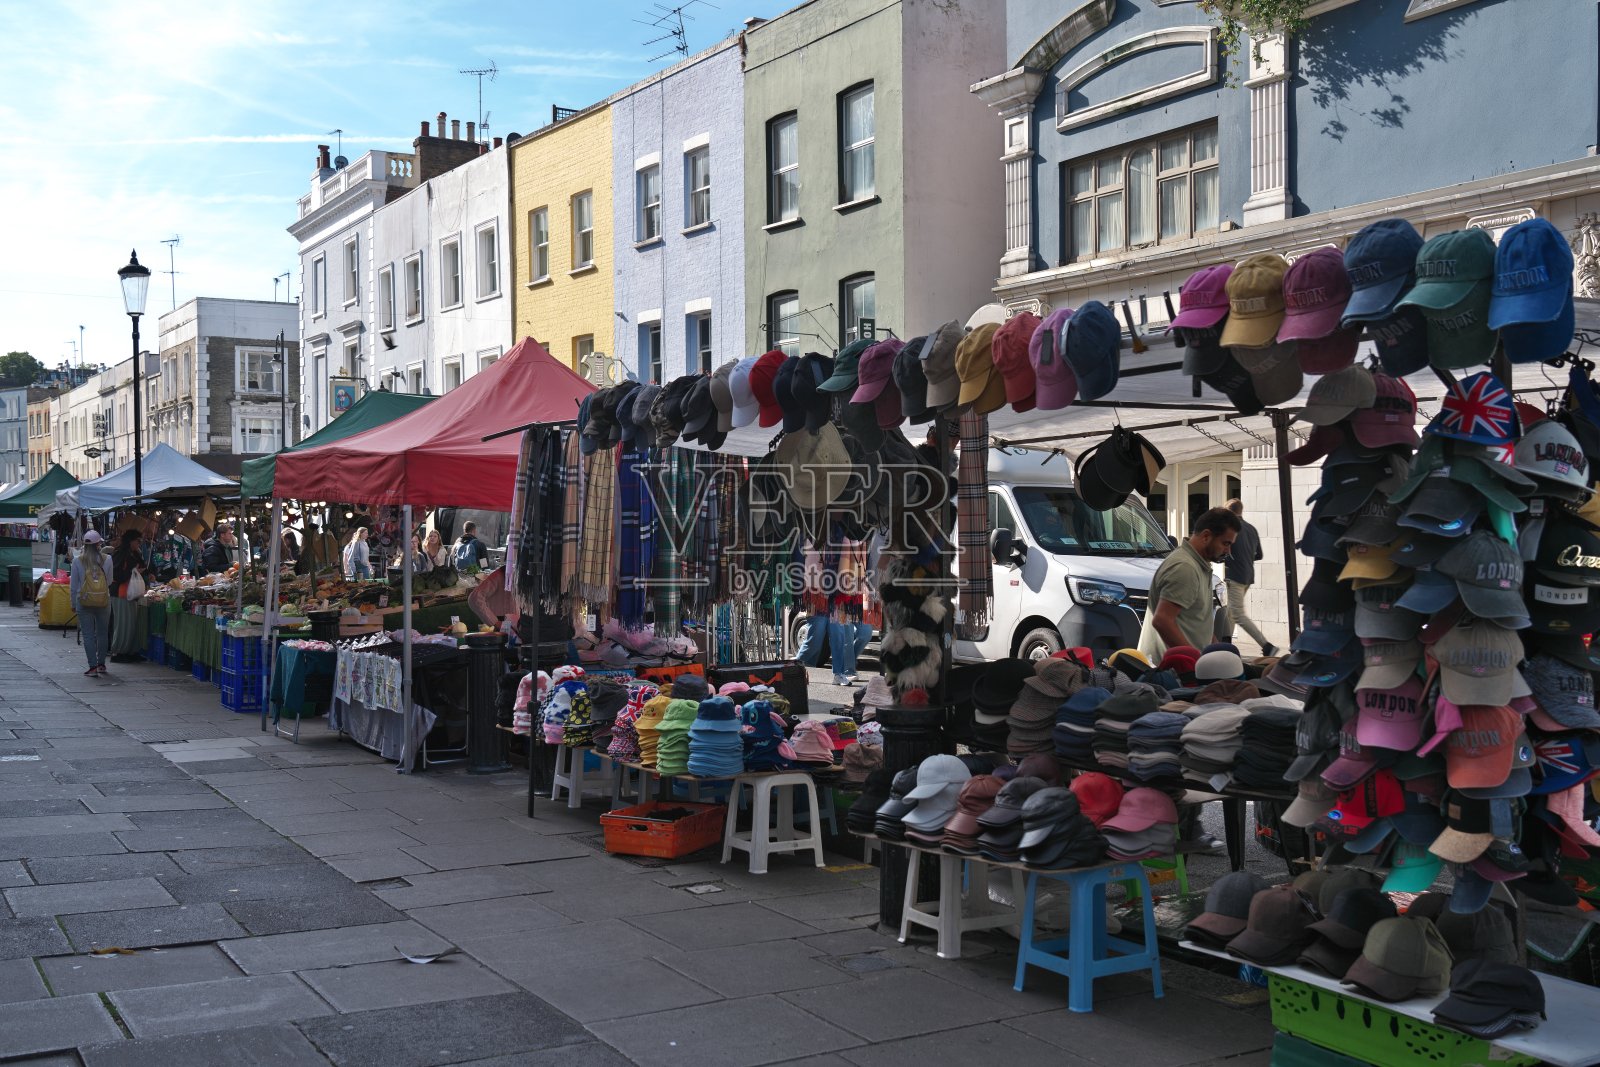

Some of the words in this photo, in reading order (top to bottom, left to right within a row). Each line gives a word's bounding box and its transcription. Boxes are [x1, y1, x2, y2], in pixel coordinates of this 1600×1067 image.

[1541, 591, 1583, 601] LONDON
[1449, 648, 1509, 669] LONDON
[1365, 693, 1417, 714] LONDON
